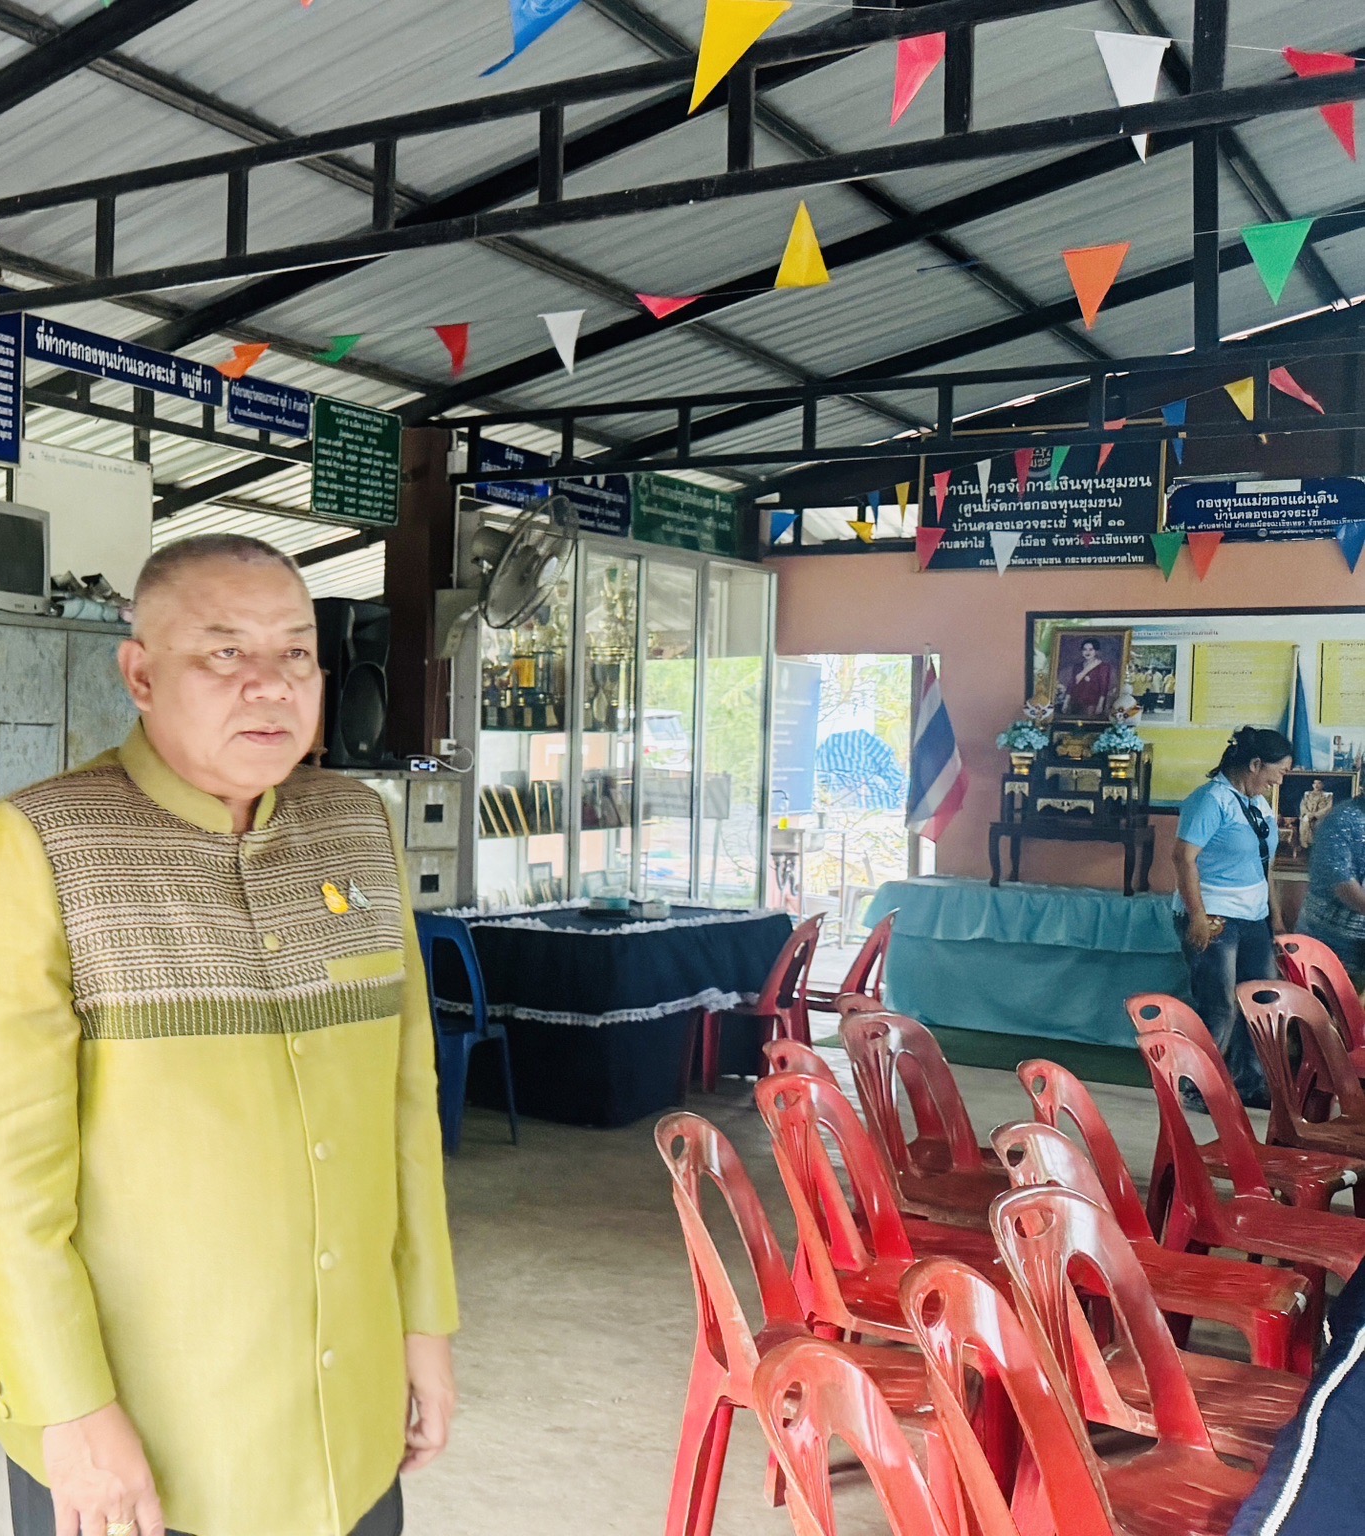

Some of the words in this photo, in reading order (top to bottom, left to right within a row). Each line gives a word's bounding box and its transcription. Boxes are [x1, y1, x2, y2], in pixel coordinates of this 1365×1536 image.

[203, 378, 212, 395] 11
[1196, 490, 1339, 511] กองทุนแม่ของแผ่นดิน
[952, 515, 1067, 532] บ้านคลองเอวจระเข้
[1072, 511, 1102, 532] หมู่ที่
[1108, 519, 1125, 527] ๑๑
[1214, 505, 1320, 521] บ้านคลองเอวจระเข้
